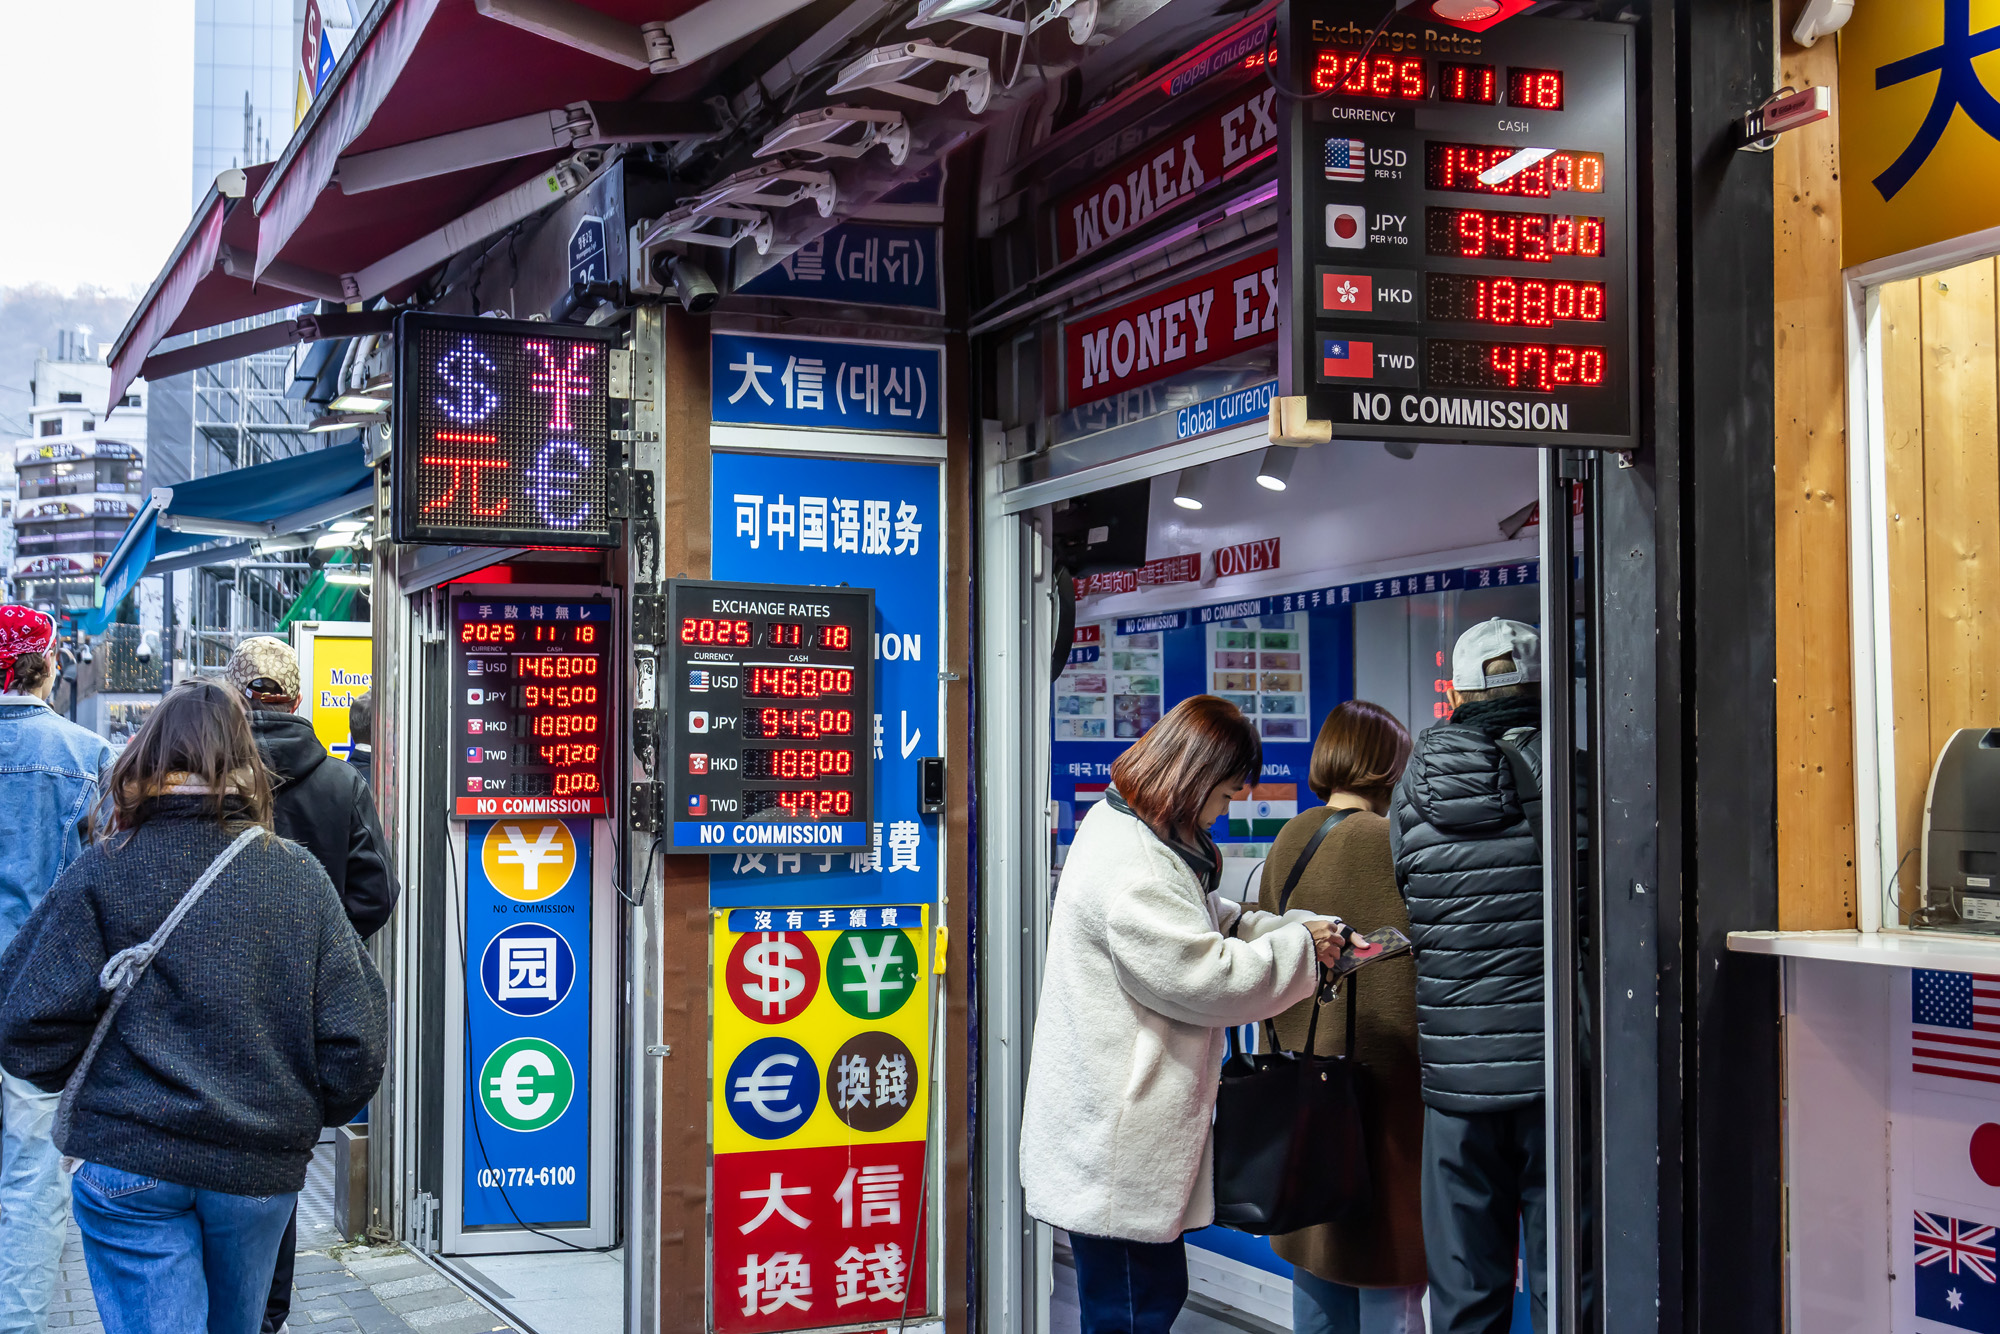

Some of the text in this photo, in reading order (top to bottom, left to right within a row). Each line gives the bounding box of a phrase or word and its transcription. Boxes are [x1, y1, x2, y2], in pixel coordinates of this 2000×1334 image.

[1311, 19, 1482, 56] Exchange Rates
[1315, 54, 1422, 95] 2025
[1457, 70, 1491, 100] 11
[1523, 74, 1558, 107] 18
[1332, 107, 1395, 123] CURRENCY
[1498, 120, 1529, 133] CASH
[1370, 148, 1407, 167] USD
[1374, 169, 1391, 178] PER
[1370, 215, 1407, 232] JPY
[1371, 235, 1386, 244] PER
[1378, 288, 1412, 303] HKD
[1082, 289, 1214, 390] MONEY
[1378, 354, 1415, 369] TWD
[1177, 383, 1277, 438] Global currency
[1353, 392, 1568, 430] NO COMMISSION
[733, 493, 922, 556] 可中国语服务
[1219, 538, 1278, 576] ONEY
[1479, 566, 1540, 587] 沒有手
[712, 599, 830, 618] EXCHANGE RATES
[1201, 600, 1261, 622] NO COMMISSION
[1126, 614, 1178, 633] NO COMMISSION
[462, 623, 594, 642] 2025 11 18
[681, 618, 848, 648] 2025 11 18
[874, 633, 921, 661] ION
[694, 652, 734, 661] CURRENCY
[789, 655, 809, 663] CASH
[485, 663, 507, 672] USD
[712, 675, 738, 688] USD
[320, 691, 354, 707] Exch
[486, 692, 506, 701] JPY
[485, 722, 507, 731] HKD
[711, 716, 737, 730] JPY
[485, 751, 507, 760] TWD
[711, 758, 738, 771] HKD
[1069, 762, 1111, 776] 태국 TH
[484, 780, 506, 789] CNY
[477, 799, 591, 813] NO COMMISSION
[711, 800, 738, 812] TWD
[700, 825, 843, 844] NO COMMISSION
[493, 904, 575, 913] NO COMMISSION
[754, 908, 898, 930] 沒有手續費
[837, 1054, 907, 1109] 換錢
